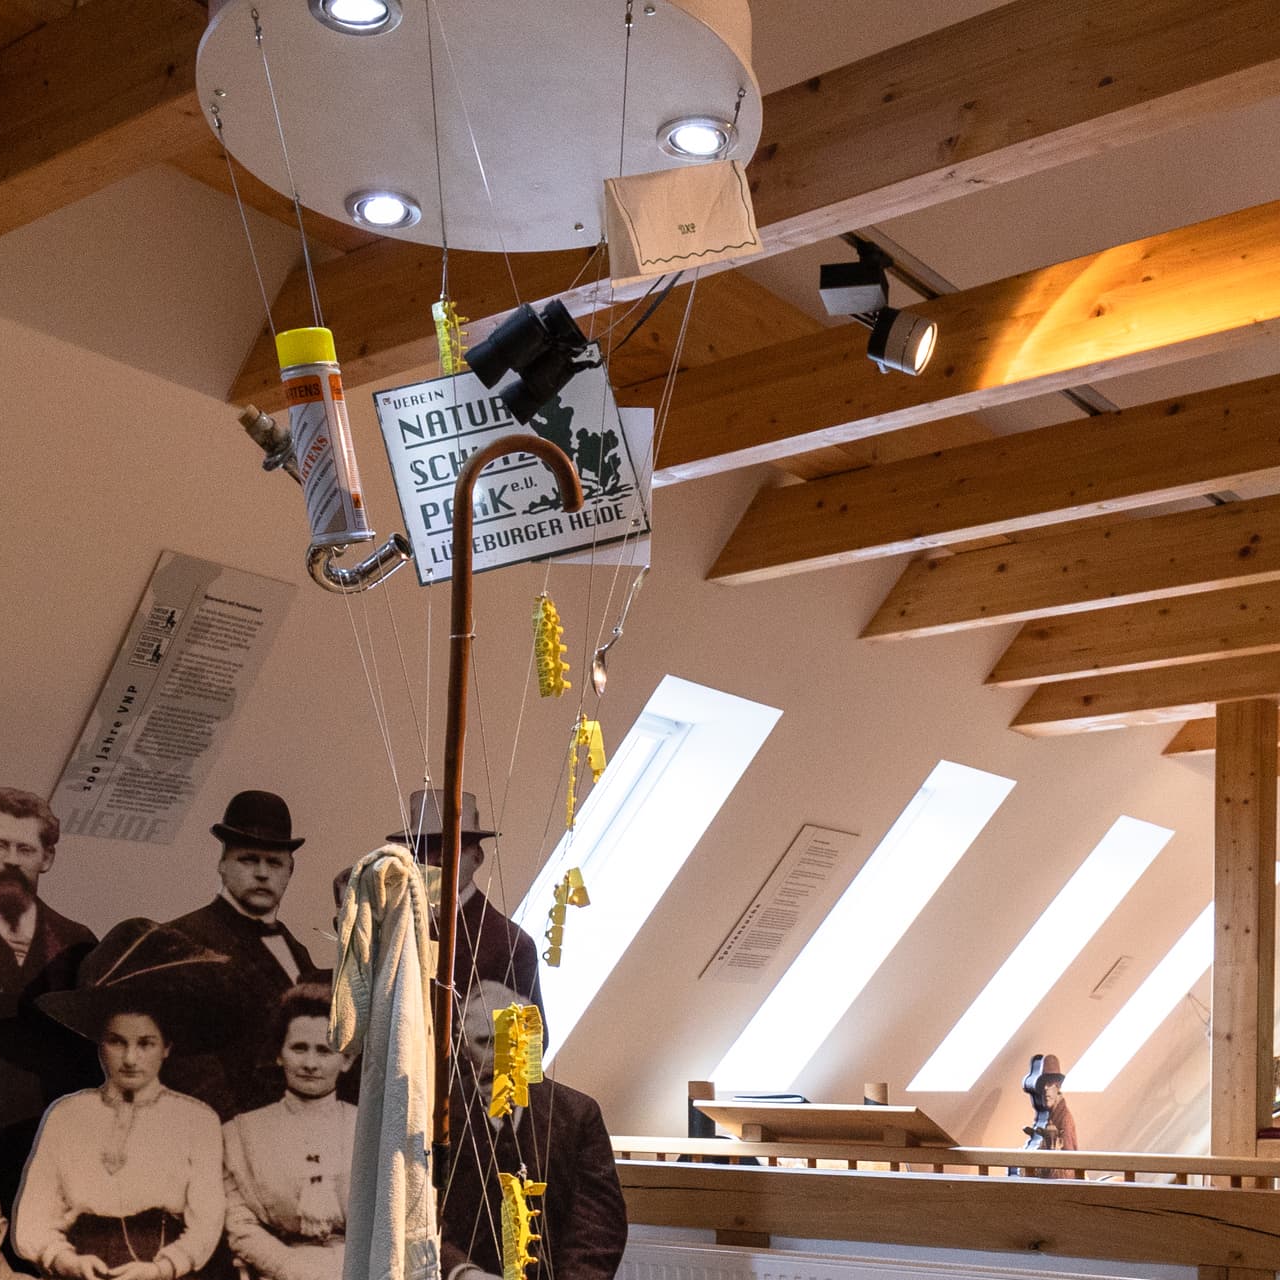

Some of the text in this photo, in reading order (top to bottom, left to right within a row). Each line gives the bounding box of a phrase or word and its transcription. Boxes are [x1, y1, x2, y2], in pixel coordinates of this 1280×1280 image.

[394, 390, 444, 410] VEREIN
[398, 396, 514, 443] NATUR
[431, 503, 626, 563] LÜEBURGER HEIDE
[118, 685, 138, 713] VNP
